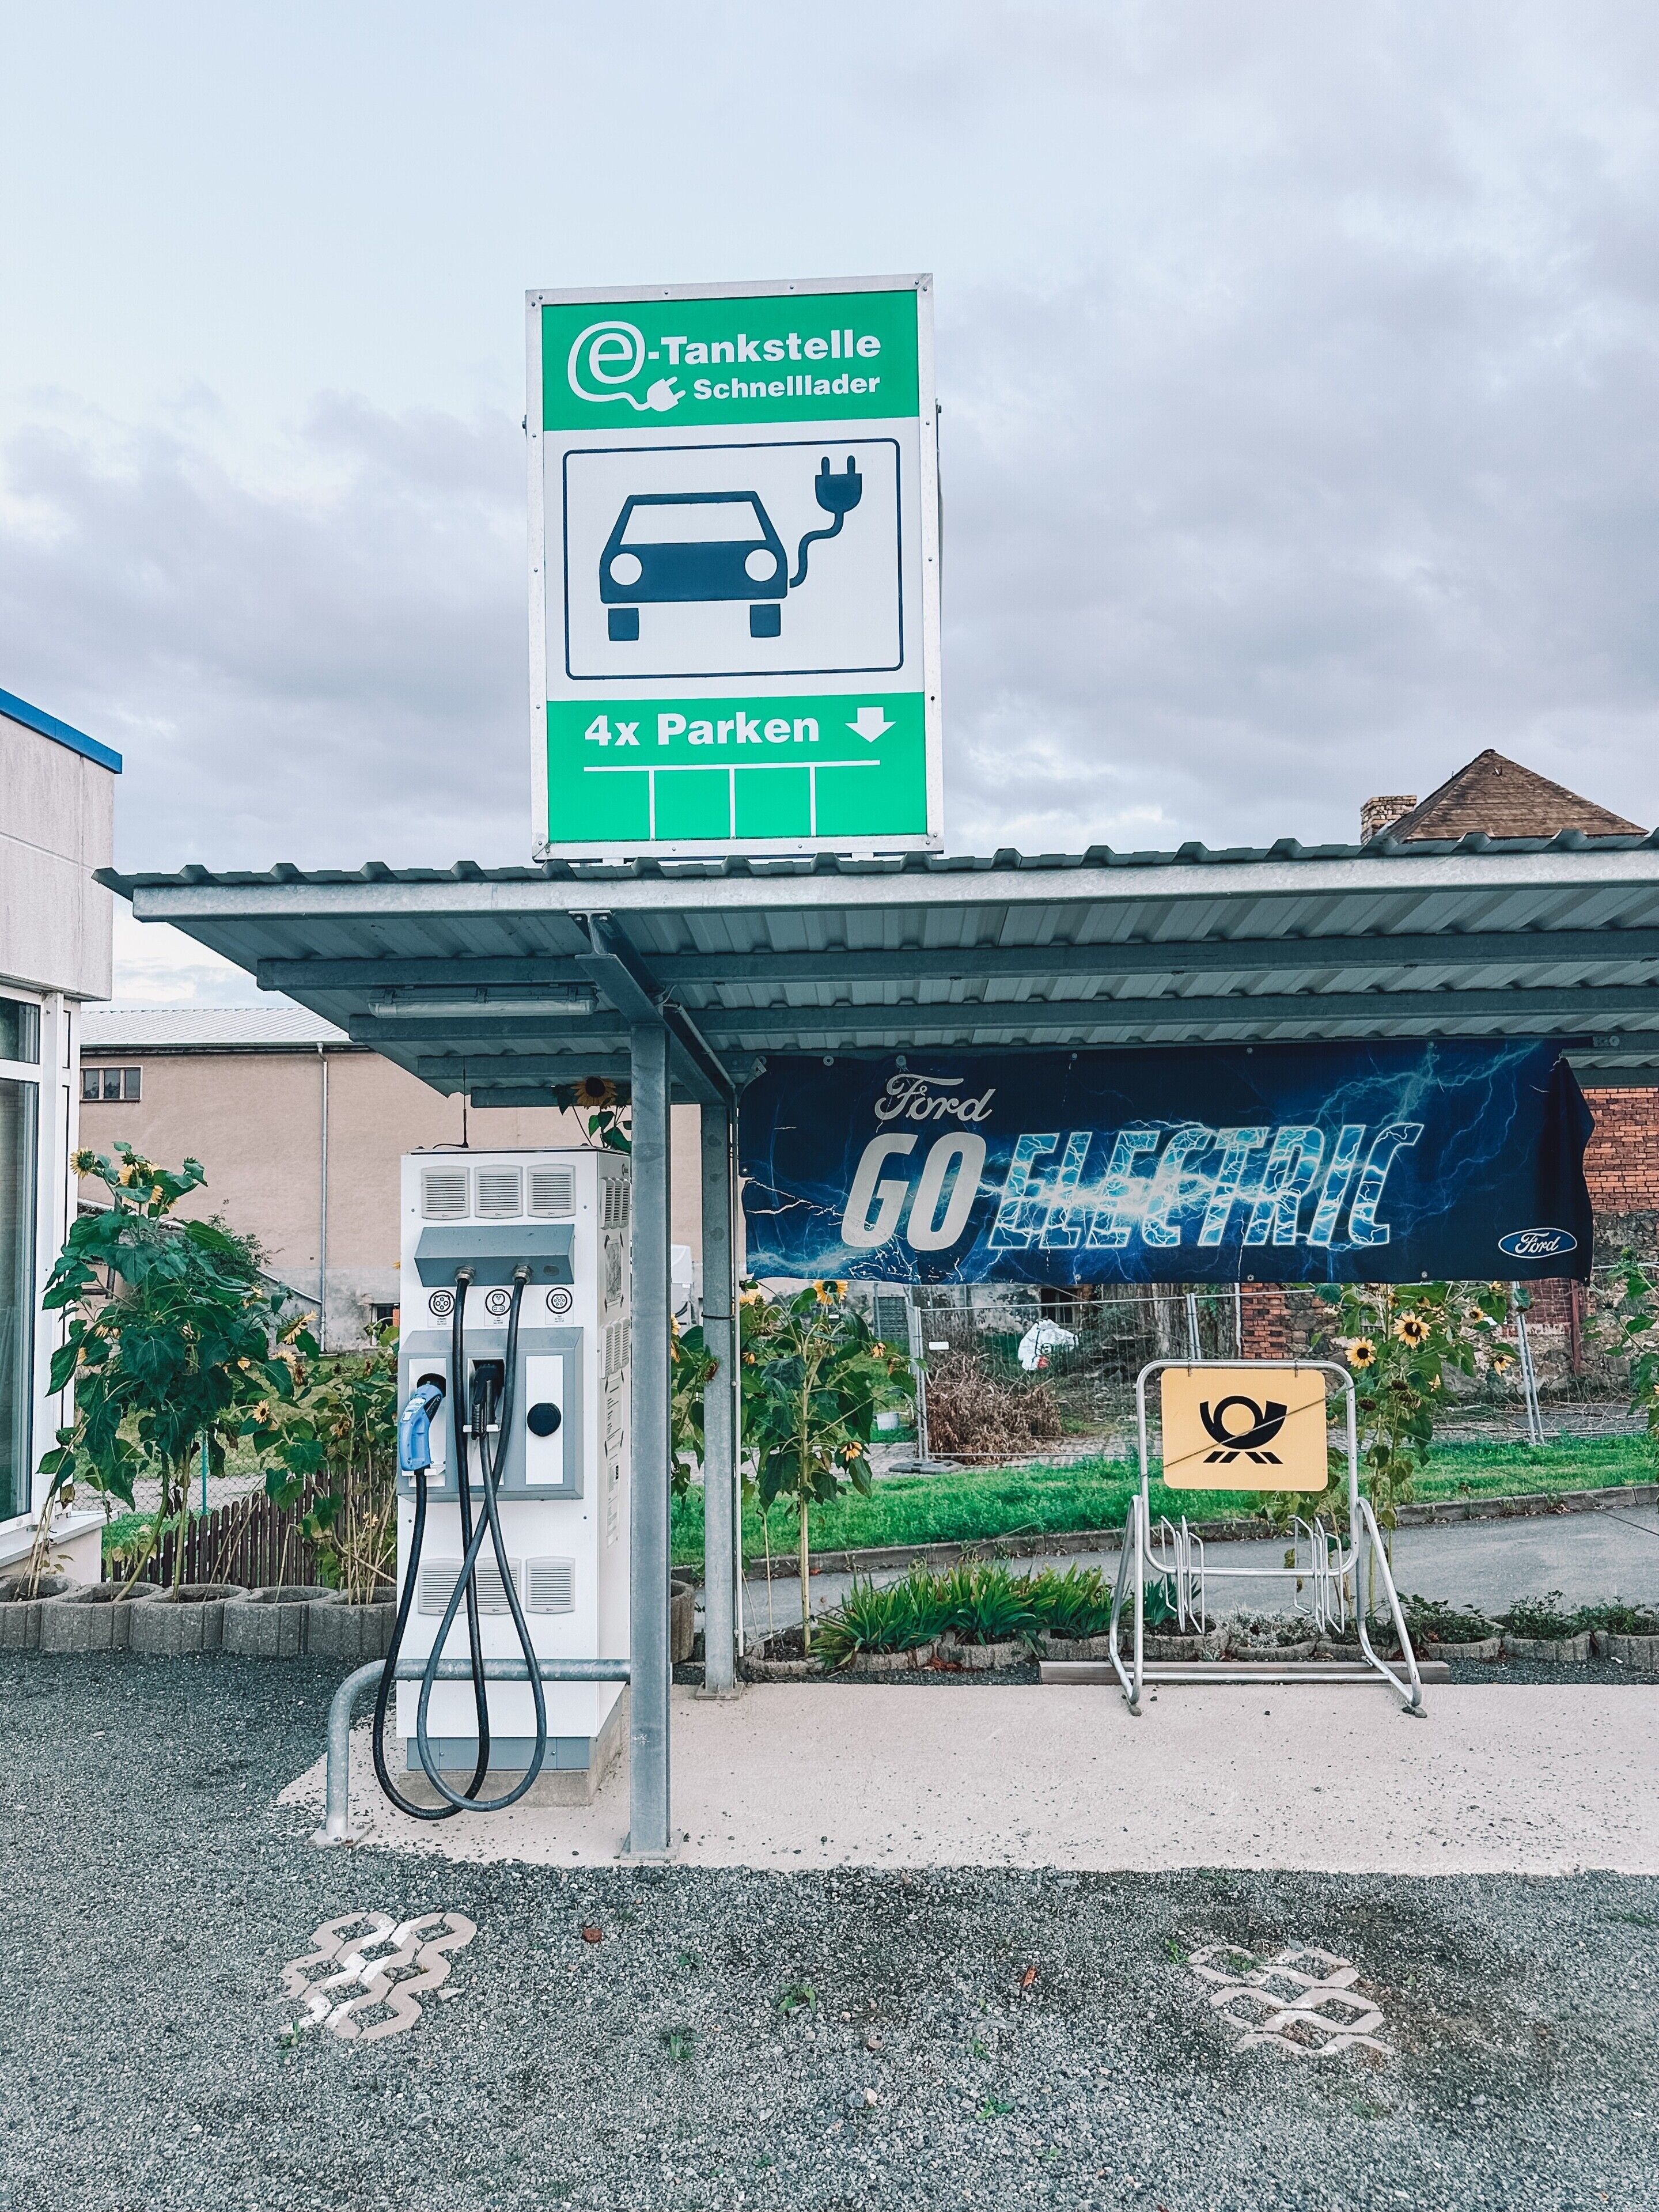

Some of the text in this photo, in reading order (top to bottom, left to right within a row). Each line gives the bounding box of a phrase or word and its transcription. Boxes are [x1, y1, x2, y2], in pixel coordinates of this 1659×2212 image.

[693, 373, 881, 400] Schnelllader
[584, 711, 819, 747] 4x Parken
[874, 1073, 996, 1122] Ford
[840, 1122, 1425, 1251] GO ELECTRIC
[1514, 1232, 1561, 1253] Ford
